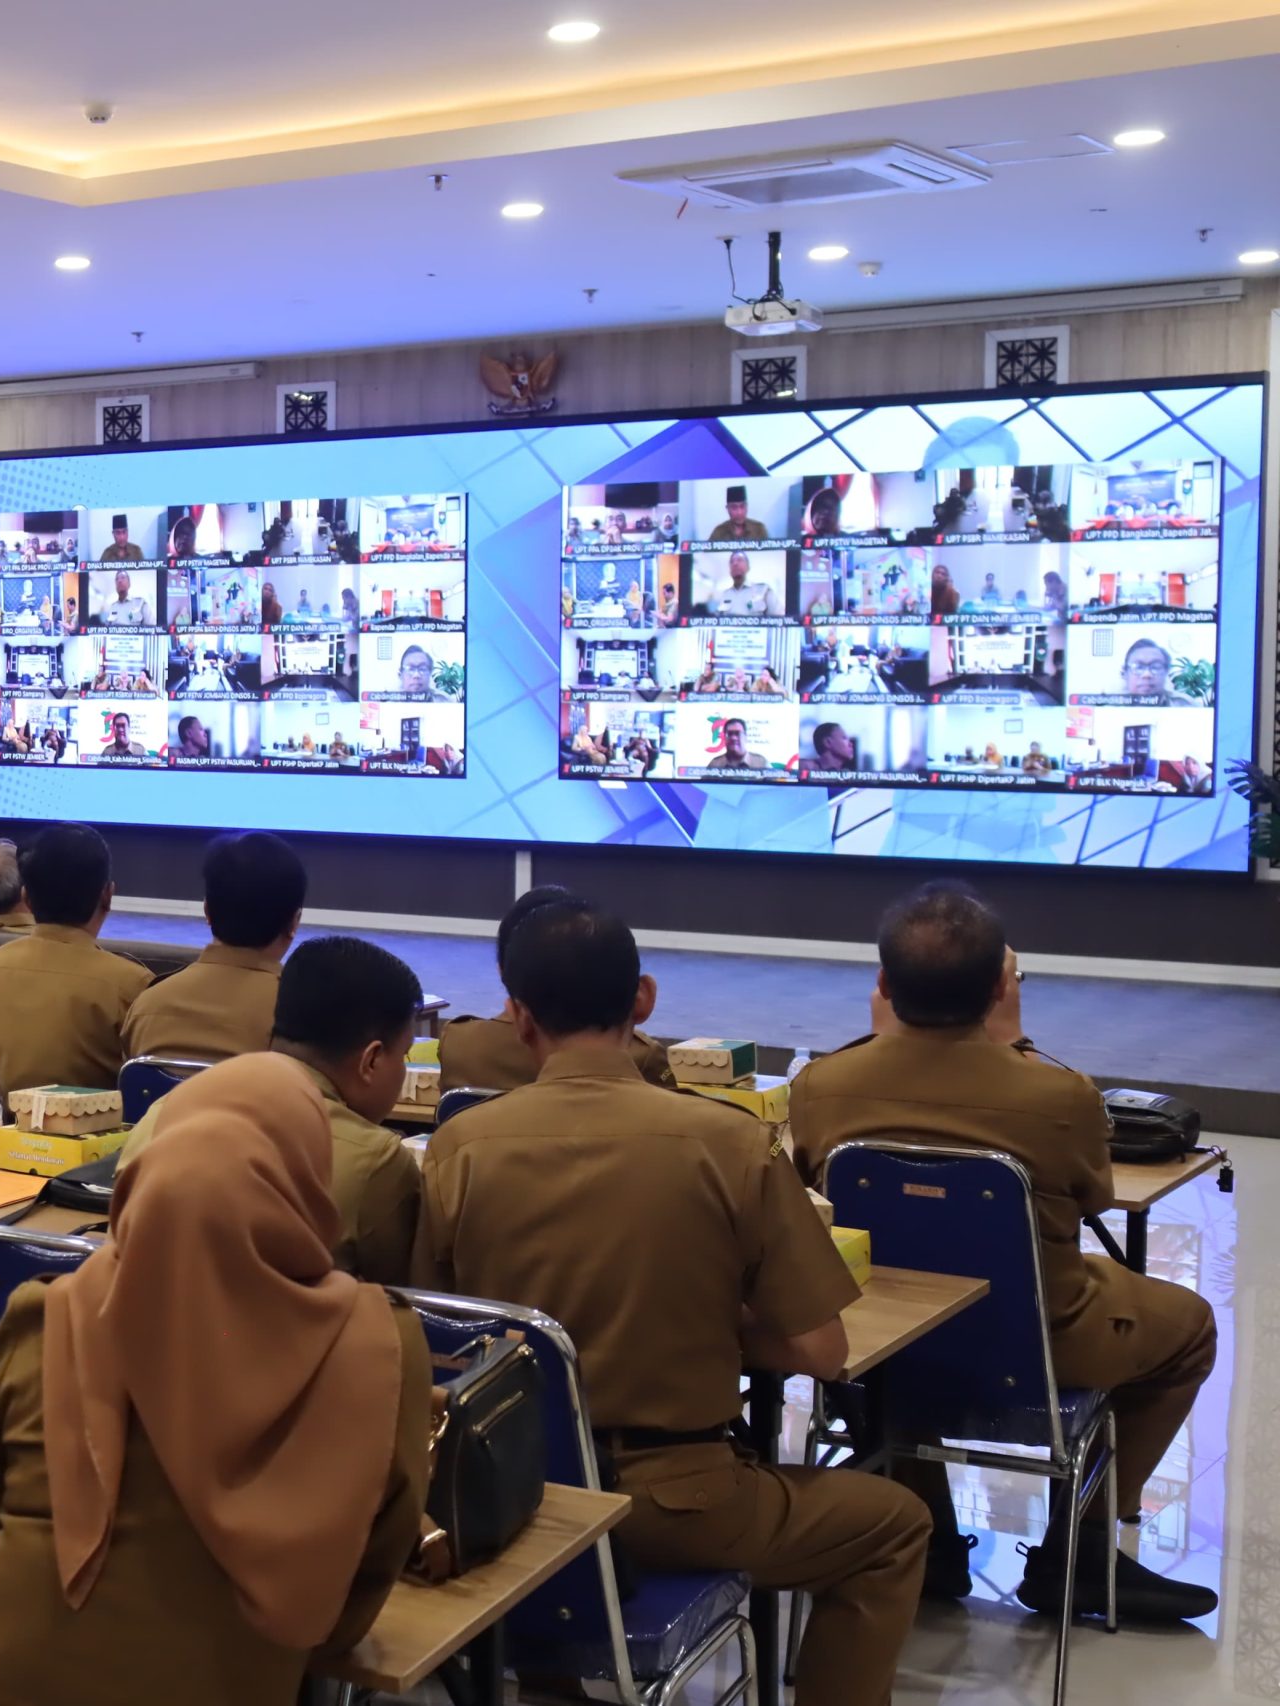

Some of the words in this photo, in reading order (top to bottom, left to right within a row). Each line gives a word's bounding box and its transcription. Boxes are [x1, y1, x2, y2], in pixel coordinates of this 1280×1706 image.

[945, 534, 960, 543] UPT
[1085, 531, 1102, 539] UPT
[814, 538, 828, 547] UPT
[851, 537, 888, 546] MAGETAN
[813, 616, 827, 624] UPT
[944, 615, 959, 623] UPT
[972, 615, 990, 623] DAN
[1141, 613, 1158, 621] UPT
[689, 617, 704, 626] UPT
[812, 693, 827, 702] UPT
[940, 774, 956, 782] UPT
[1079, 778, 1095, 786] UPT
